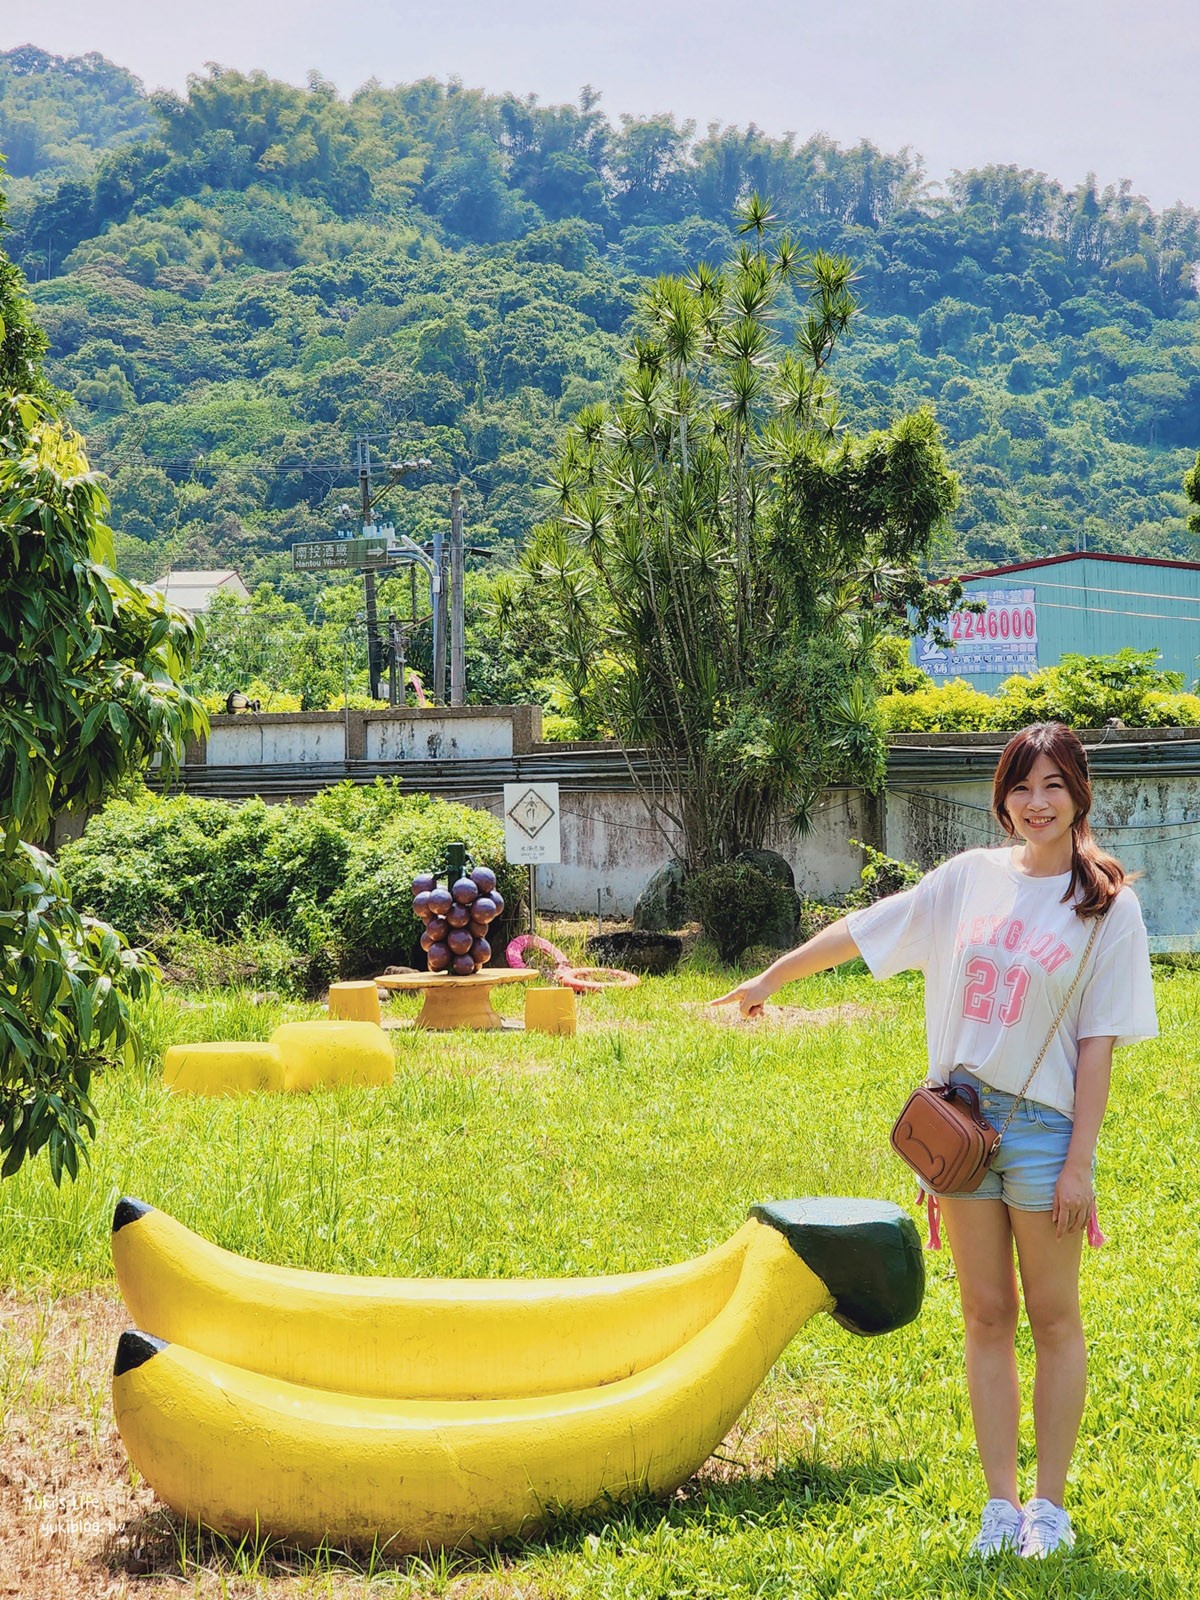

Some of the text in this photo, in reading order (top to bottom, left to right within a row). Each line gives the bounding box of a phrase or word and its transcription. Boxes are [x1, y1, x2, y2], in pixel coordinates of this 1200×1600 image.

[296, 543, 348, 559] 南投酒廠
[295, 560, 321, 568] Nantou
[951, 607, 1035, 640] 2246000
[962, 955, 1032, 1028] 23
